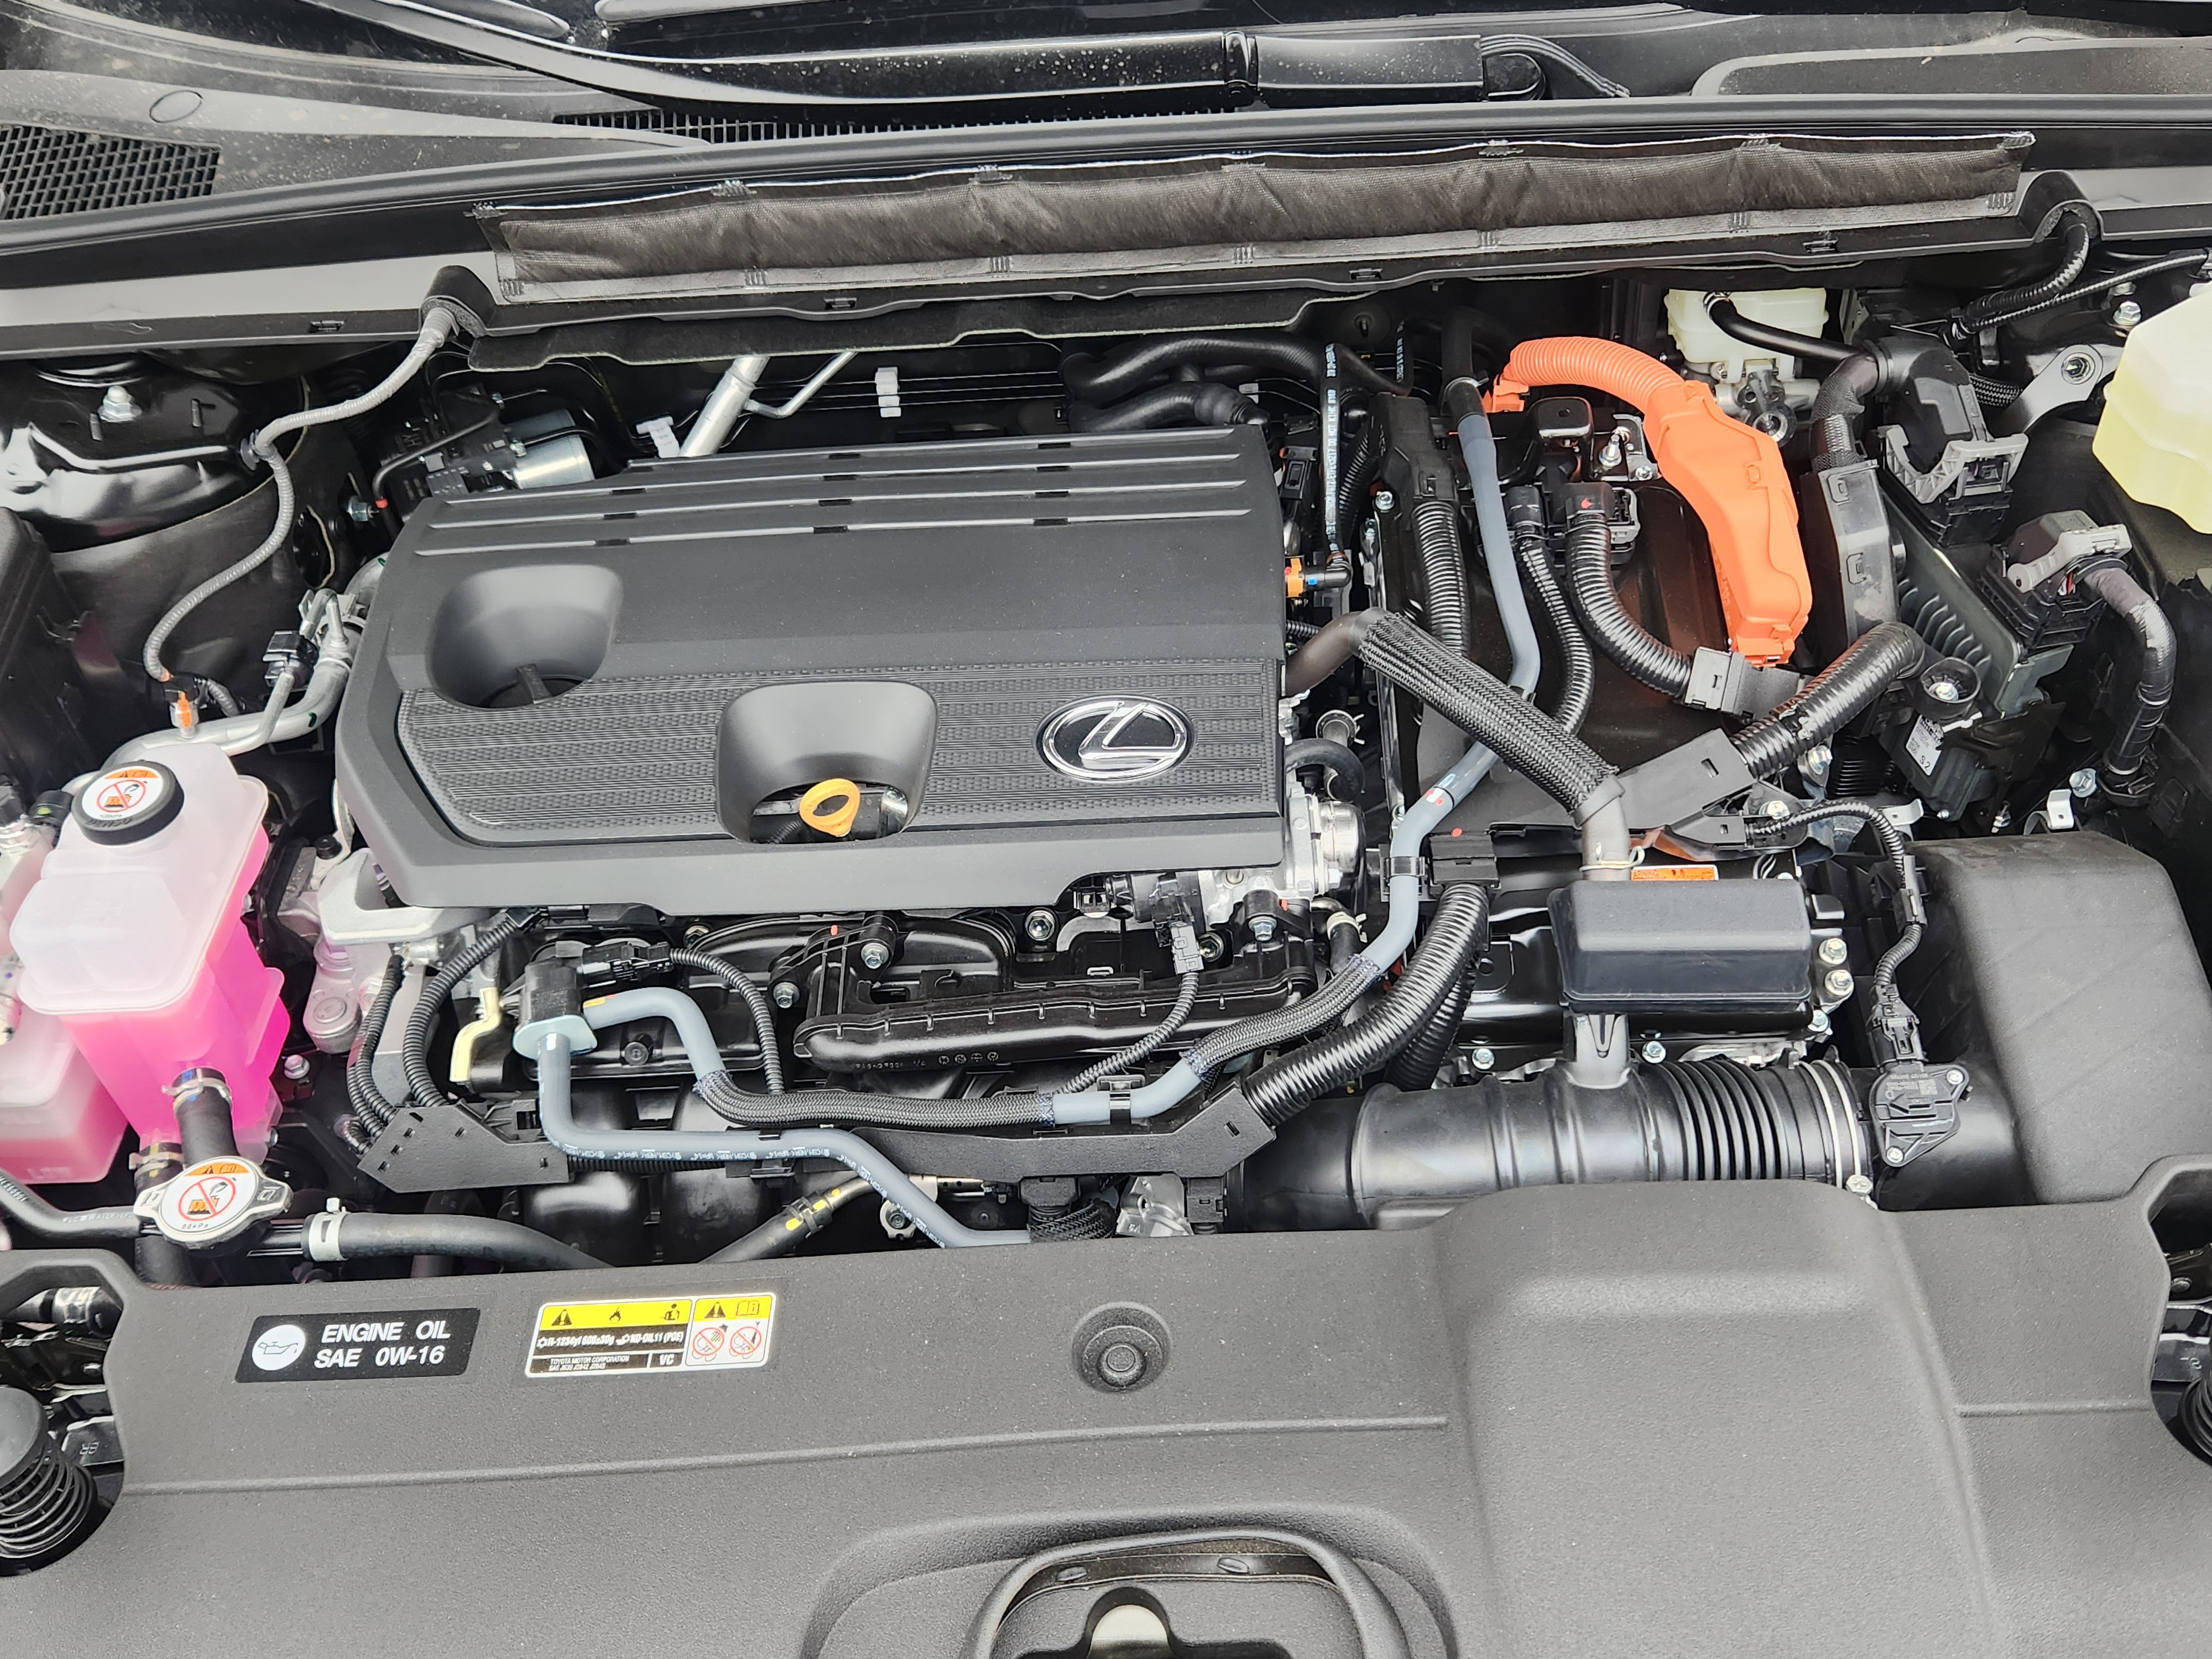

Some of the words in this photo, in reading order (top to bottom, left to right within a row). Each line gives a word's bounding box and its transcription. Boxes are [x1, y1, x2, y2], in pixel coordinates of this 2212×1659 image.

[321, 1322, 405, 1343] ENGINE
[416, 1320, 451, 1340] OIL
[314, 1348, 362, 1369] SAE
[375, 1345, 445, 1366] 0W-16
[591, 1355, 630, 1364] CORPORATION
[659, 1353, 675, 1366] VC
